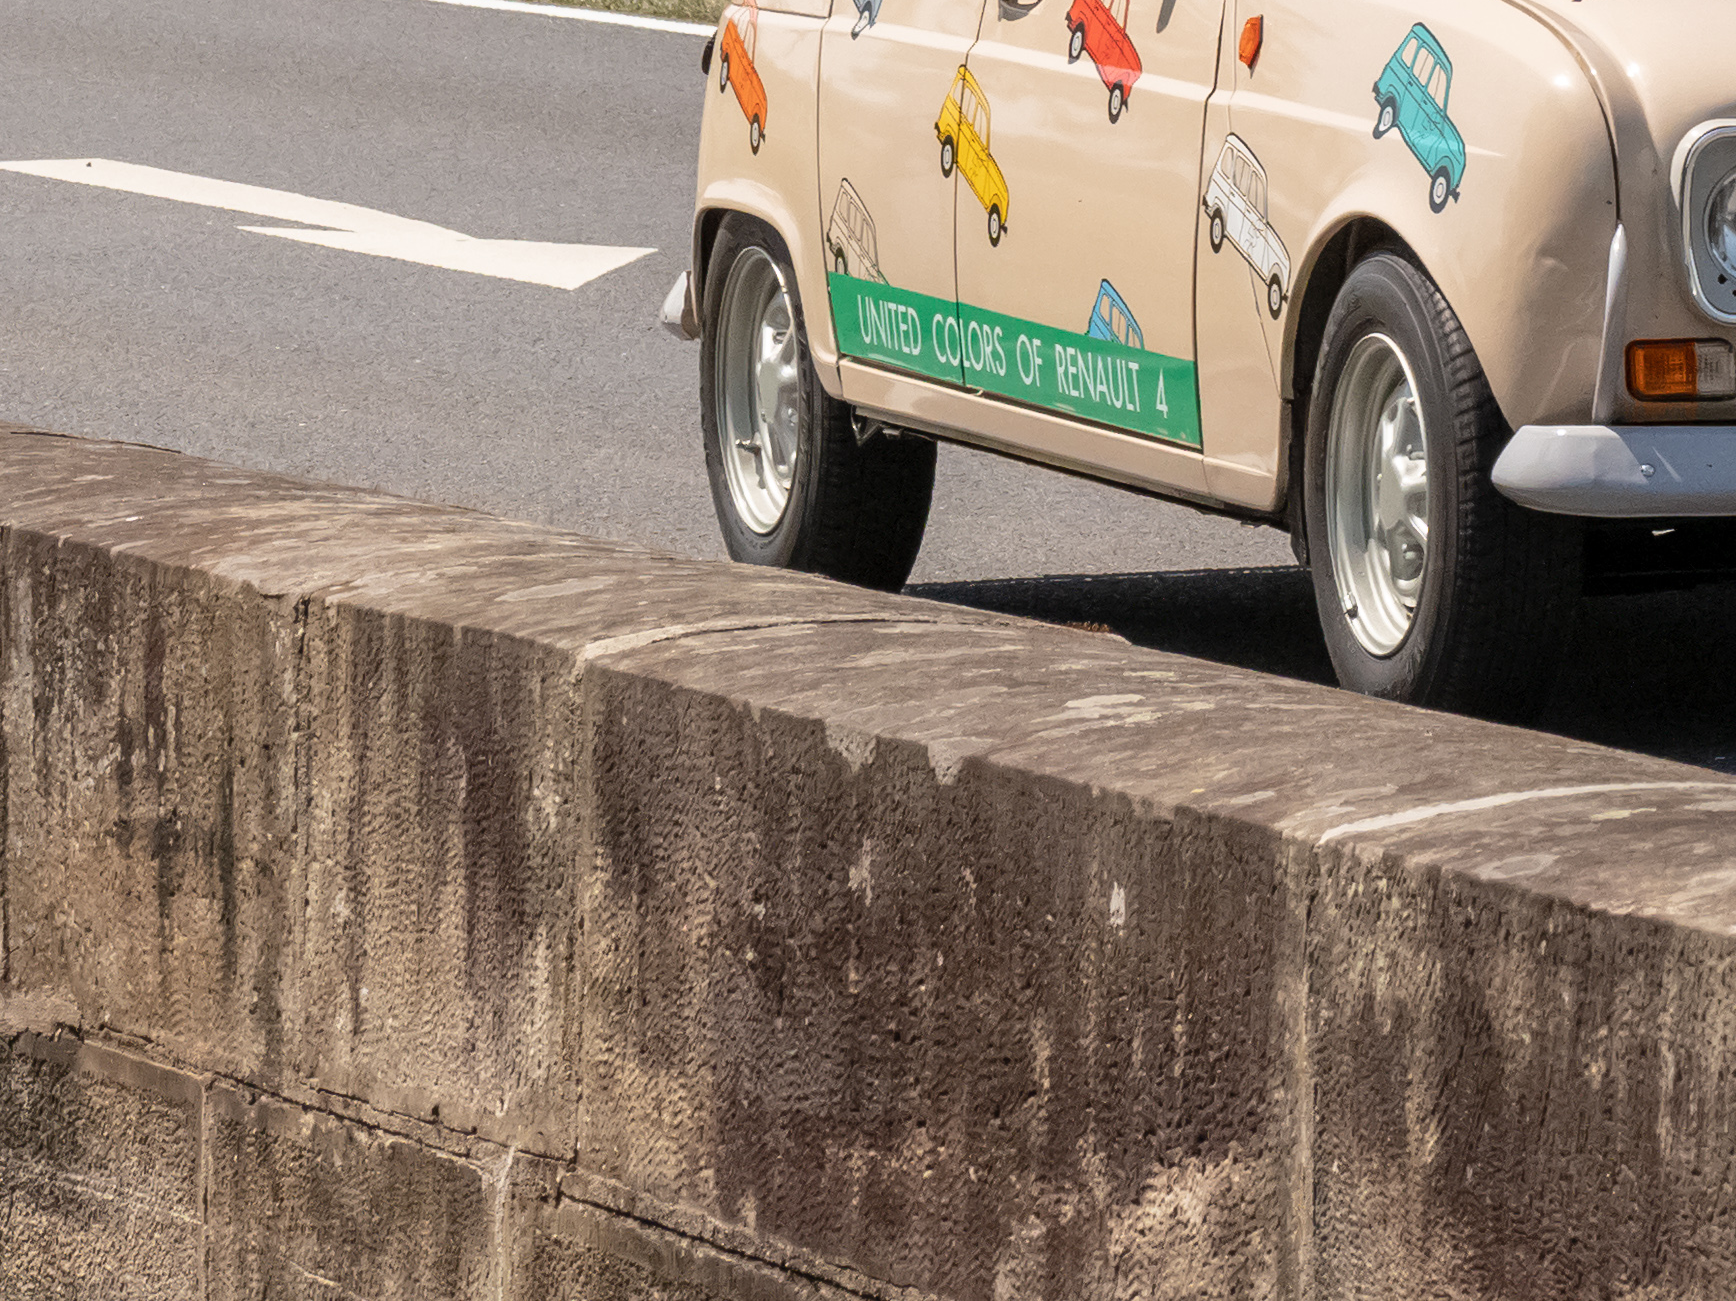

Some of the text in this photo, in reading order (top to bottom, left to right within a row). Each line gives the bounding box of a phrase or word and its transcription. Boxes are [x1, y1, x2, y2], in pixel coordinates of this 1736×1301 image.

[857, 294, 1169, 419] UNITED COLORS OF RENAULT 4
